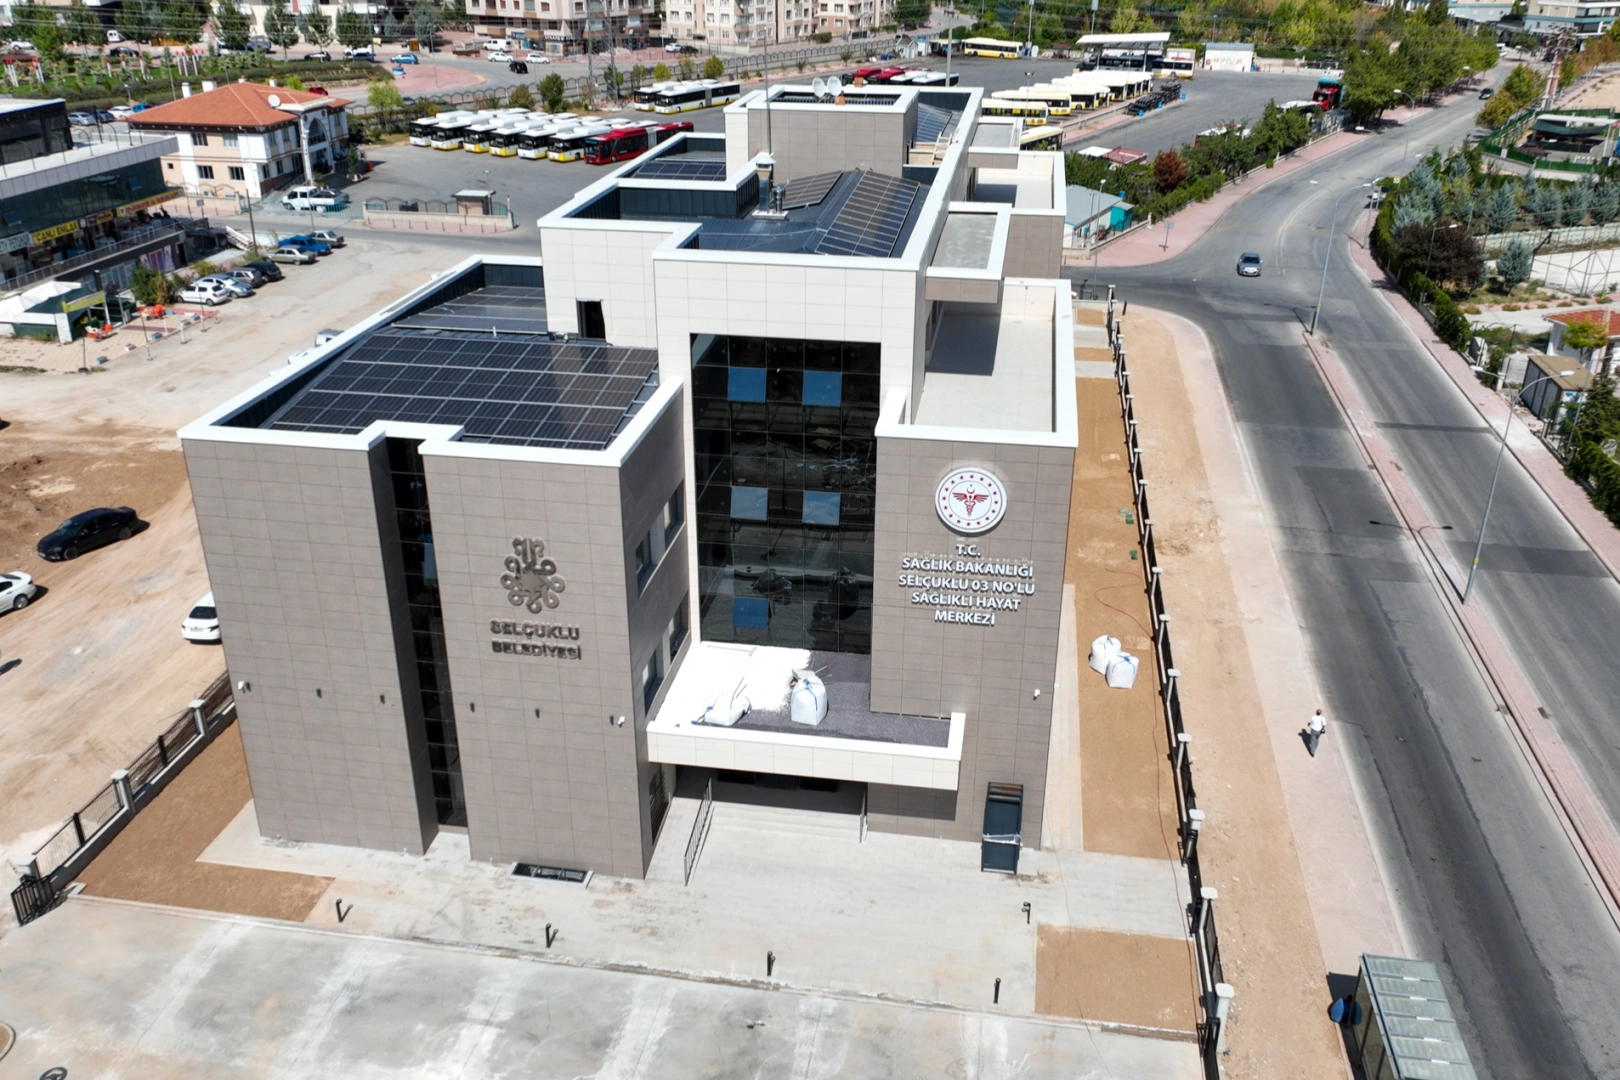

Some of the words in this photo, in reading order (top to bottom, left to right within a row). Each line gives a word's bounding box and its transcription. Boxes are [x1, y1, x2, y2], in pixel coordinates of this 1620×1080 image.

[956, 543, 981, 556] T.C.
[902, 557, 953, 572] SAĞLIK
[955, 561, 1033, 578] BAKANLIĞI
[899, 575, 969, 590] SELÇUKLU
[971, 580, 989, 591] 03
[992, 582, 1035, 595] NO'LU
[911, 592, 972, 607] SAĞLIKLI
[976, 598, 1021, 611] HAYAT
[934, 610, 996, 625] MERKEZİ
[490, 619, 580, 641] SELÇUKLU
[491, 638, 582, 660] BELEDİYESİ
